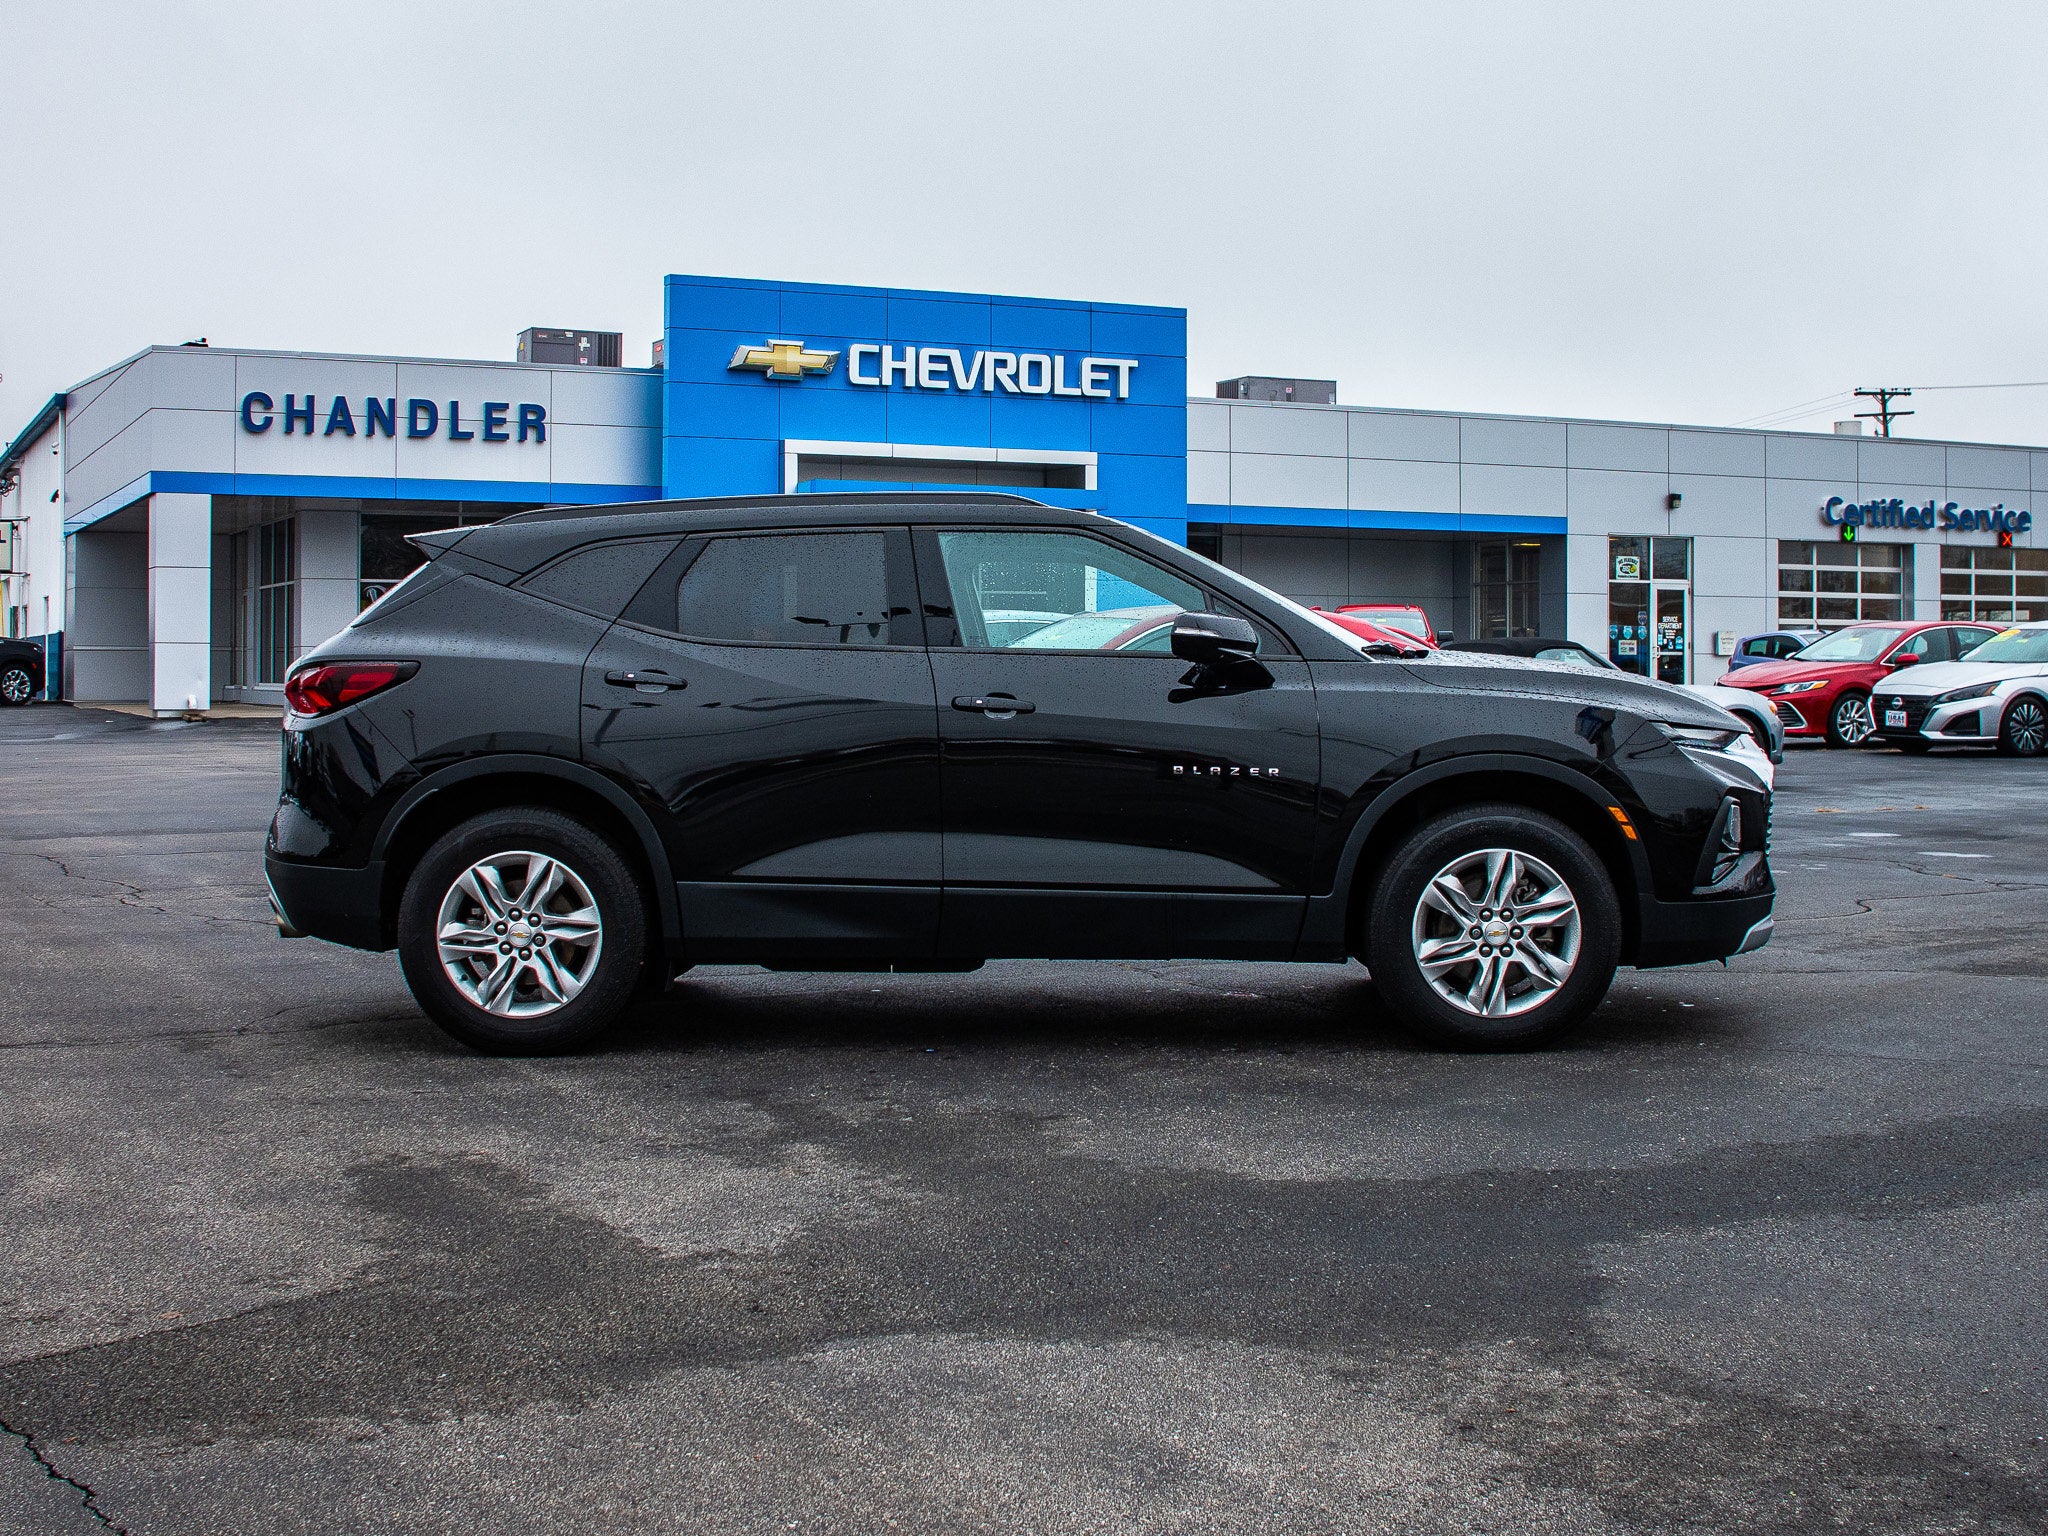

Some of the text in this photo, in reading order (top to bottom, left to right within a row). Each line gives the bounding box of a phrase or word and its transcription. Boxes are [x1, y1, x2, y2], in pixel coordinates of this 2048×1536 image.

[848, 343, 1139, 399] CHEVROLET
[241, 391, 547, 442] CHANDLER
[1825, 496, 2032, 532] Certified Service
[1173, 765, 1280, 777] BLAZER
